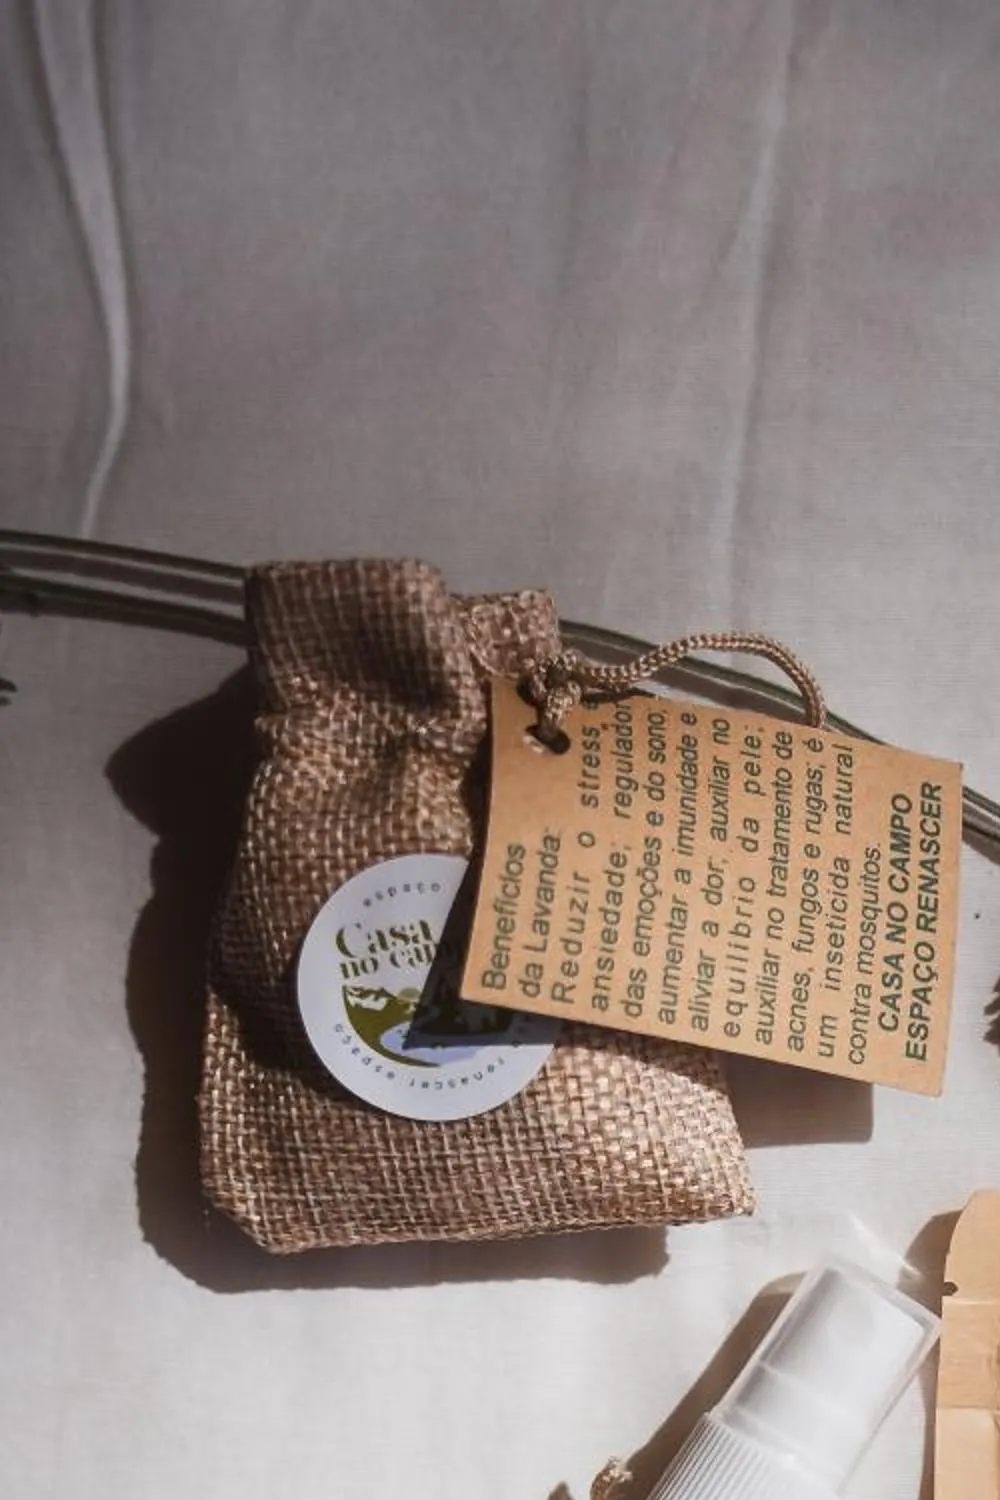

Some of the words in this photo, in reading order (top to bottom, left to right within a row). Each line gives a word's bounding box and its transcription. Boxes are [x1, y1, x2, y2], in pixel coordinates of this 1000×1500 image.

[681, 713, 697, 726] e
[712, 718, 730, 745] no
[772, 731, 792, 760] de
[802, 738, 824, 752] é
[643, 771, 665, 801] do
[646, 811, 664, 826] e
[672, 734, 698, 856] imunidade
[708, 755, 730, 842] auxiliar
[805, 762, 828, 834] rugas;
[832, 744, 853, 835] natural
[736, 817, 759, 852] da
[766, 767, 792, 897] tratamento
[804, 844, 821, 859] e
[888, 794, 912, 893] CAMPO
[916, 782, 942, 934] RENASCER
[633, 836, 662, 956] emoções
[674, 868, 691, 885] a
[791, 868, 822, 953] fungos
[857, 843, 883, 975] mosquitos.
[335, 919, 434, 959] Casa
[551, 872, 590, 1004] Reduzir
[577, 832, 595, 848] o
[702, 920, 719, 937] a
[766, 907, 784, 940] no
[820, 857, 850, 991] inseticida
[885, 901, 908, 944] NO
[338, 956, 378, 980] no
[518, 963, 543, 998] da
[620, 968, 647, 1018] das
[658, 894, 688, 1024] aumentar
[688, 949, 716, 1031] aliviar
[724, 877, 756, 1038] equilíbrio
[878, 953, 905, 1032] CASA
[755, 948, 780, 1045] auxiliar
[848, 983, 872, 1064] contra
[905, 941, 938, 1061] ESPAÇO
[818, 1015, 838, 1058] um
